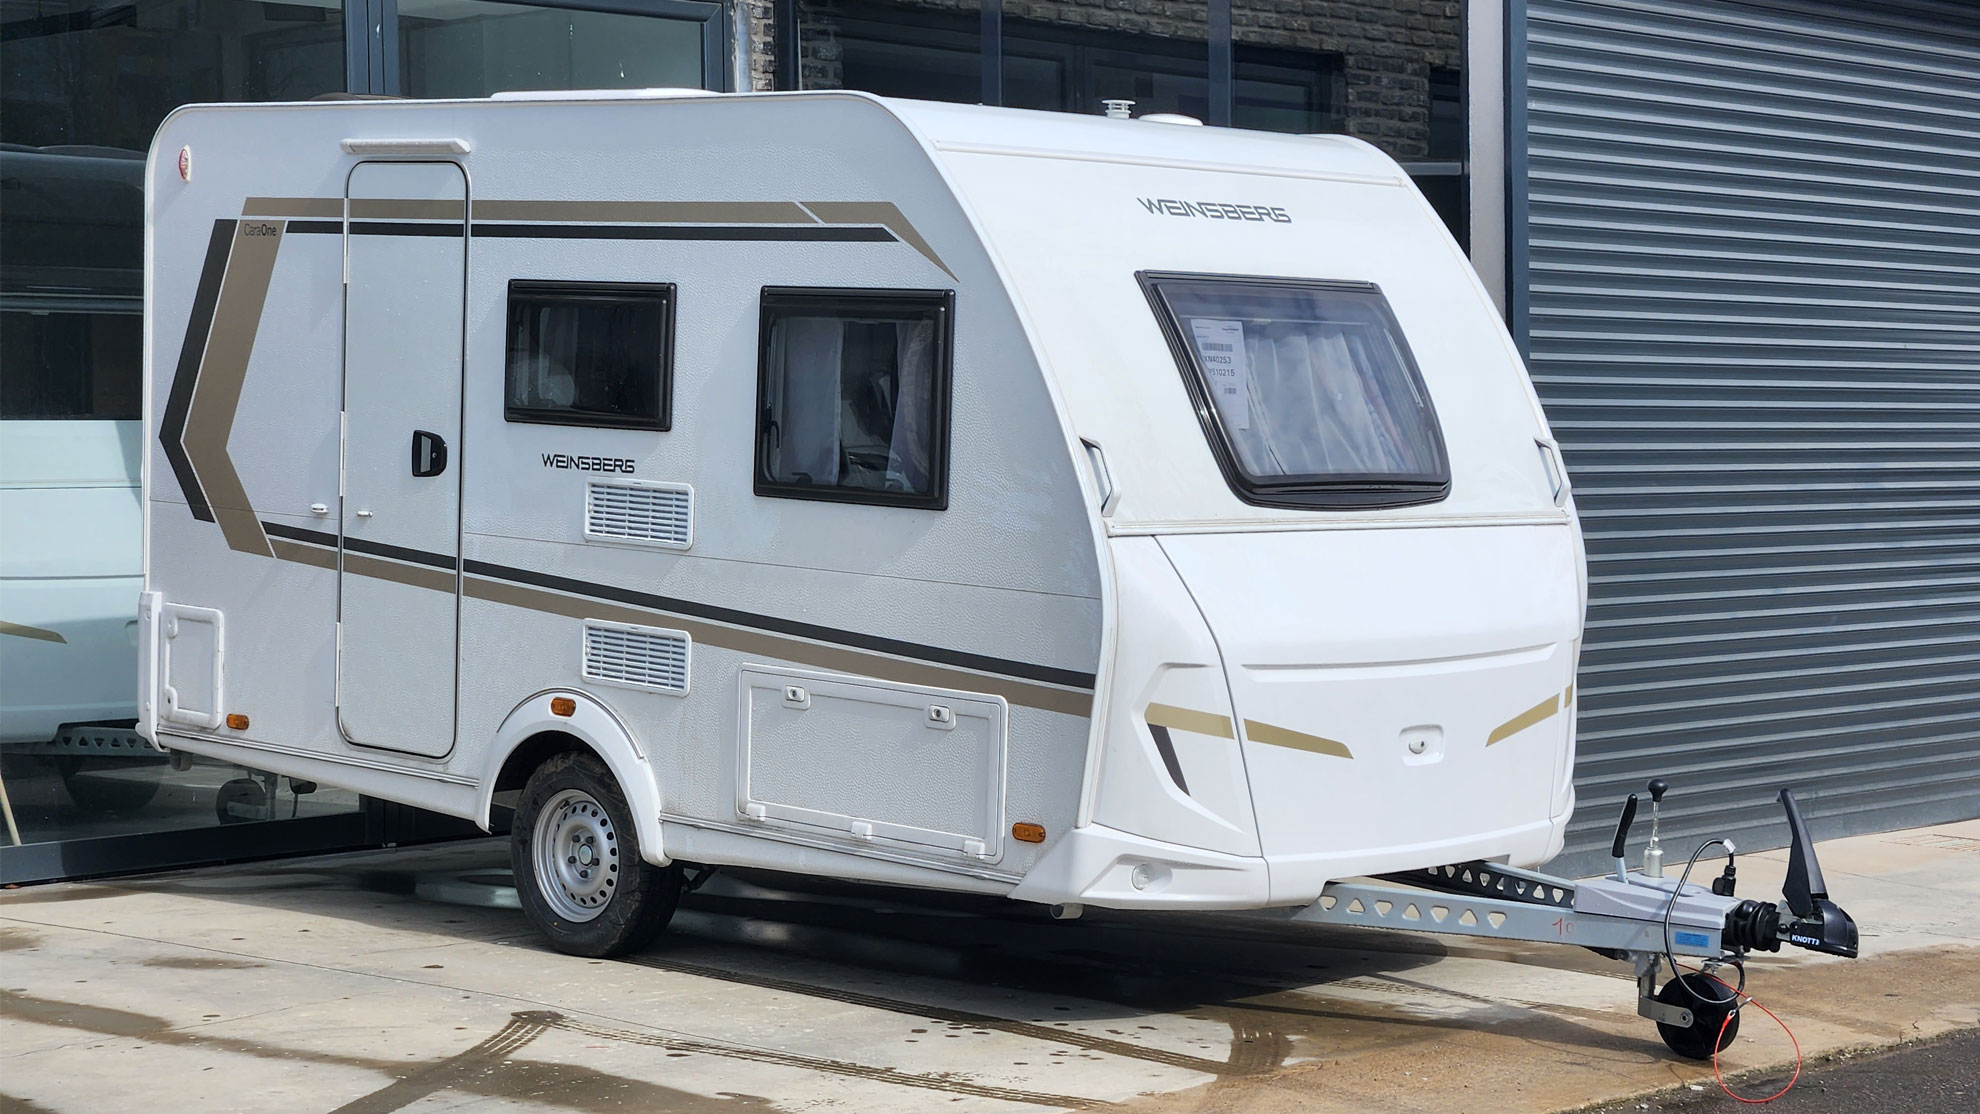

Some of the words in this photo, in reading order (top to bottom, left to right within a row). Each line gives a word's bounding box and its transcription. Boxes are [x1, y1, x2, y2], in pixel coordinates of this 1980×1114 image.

[1136, 197, 1292, 223] WEINSBERG
[244, 223, 277, 236] CaraOne
[541, 453, 635, 473] WEINSBERG
